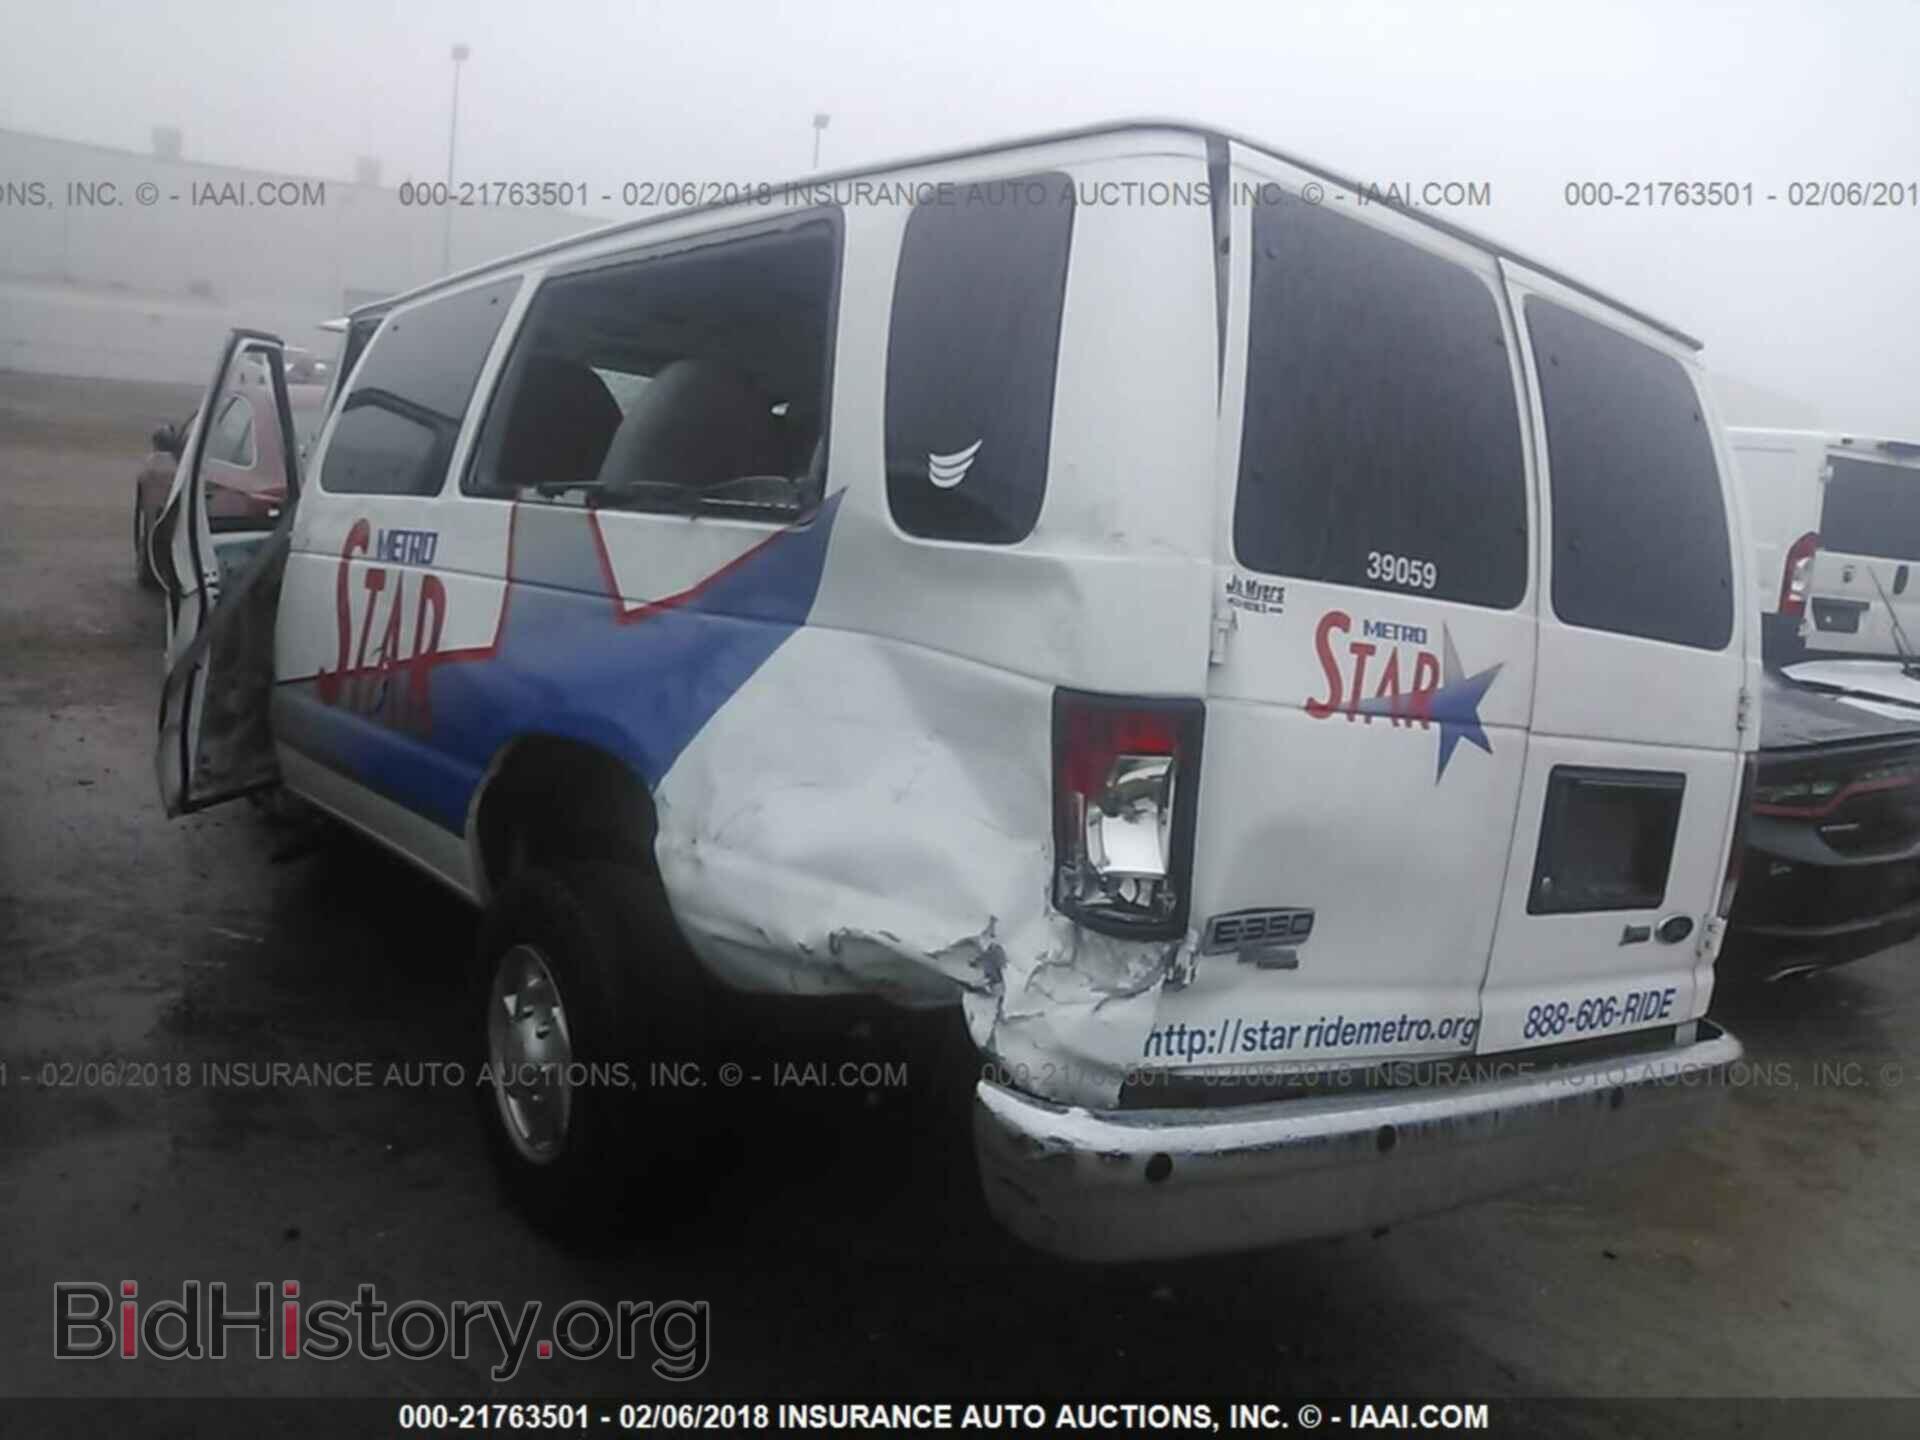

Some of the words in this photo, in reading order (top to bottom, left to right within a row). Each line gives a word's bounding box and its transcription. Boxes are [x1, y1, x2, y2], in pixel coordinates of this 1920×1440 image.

[376, 528, 438, 565] METRO
[1366, 551, 1437, 590] 39059
[316, 517, 447, 738] STAR
[1363, 619, 1428, 645] METRO
[1304, 610, 1441, 731] STAR
[1523, 987, 1677, 1041] 888-606-RIDE
